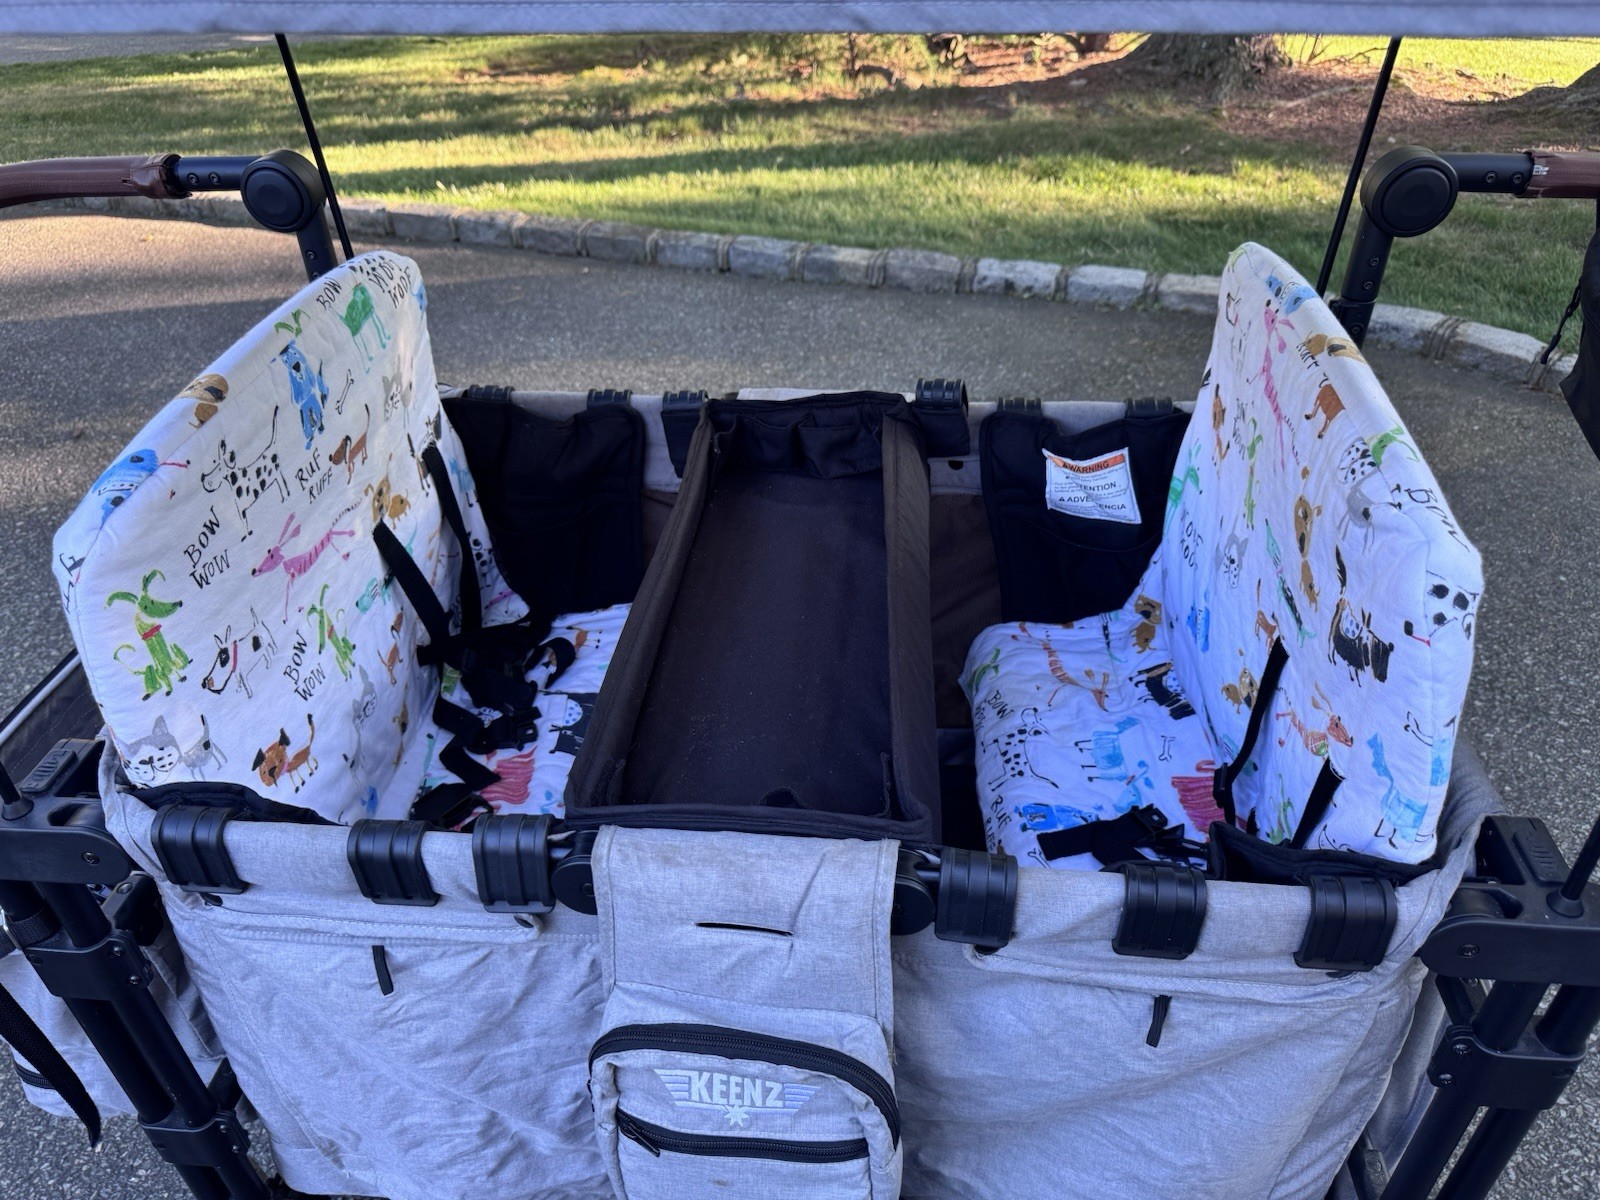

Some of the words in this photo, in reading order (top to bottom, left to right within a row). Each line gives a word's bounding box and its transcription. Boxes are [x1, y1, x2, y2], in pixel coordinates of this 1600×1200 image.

[316, 277, 342, 310] BOW
[295, 447, 321, 491] RUF
[308, 466, 333, 504] RUFF
[1068, 460, 1110, 474] WARNING
[183, 505, 221, 569] BOW
[189, 548, 230, 590] WOW
[283, 629, 308, 685] BOW
[294, 662, 326, 702] WOW
[987, 689, 1015, 719] BOW
[991, 794, 1012, 829] RUF
[690, 1071, 784, 1108] KEENZ
